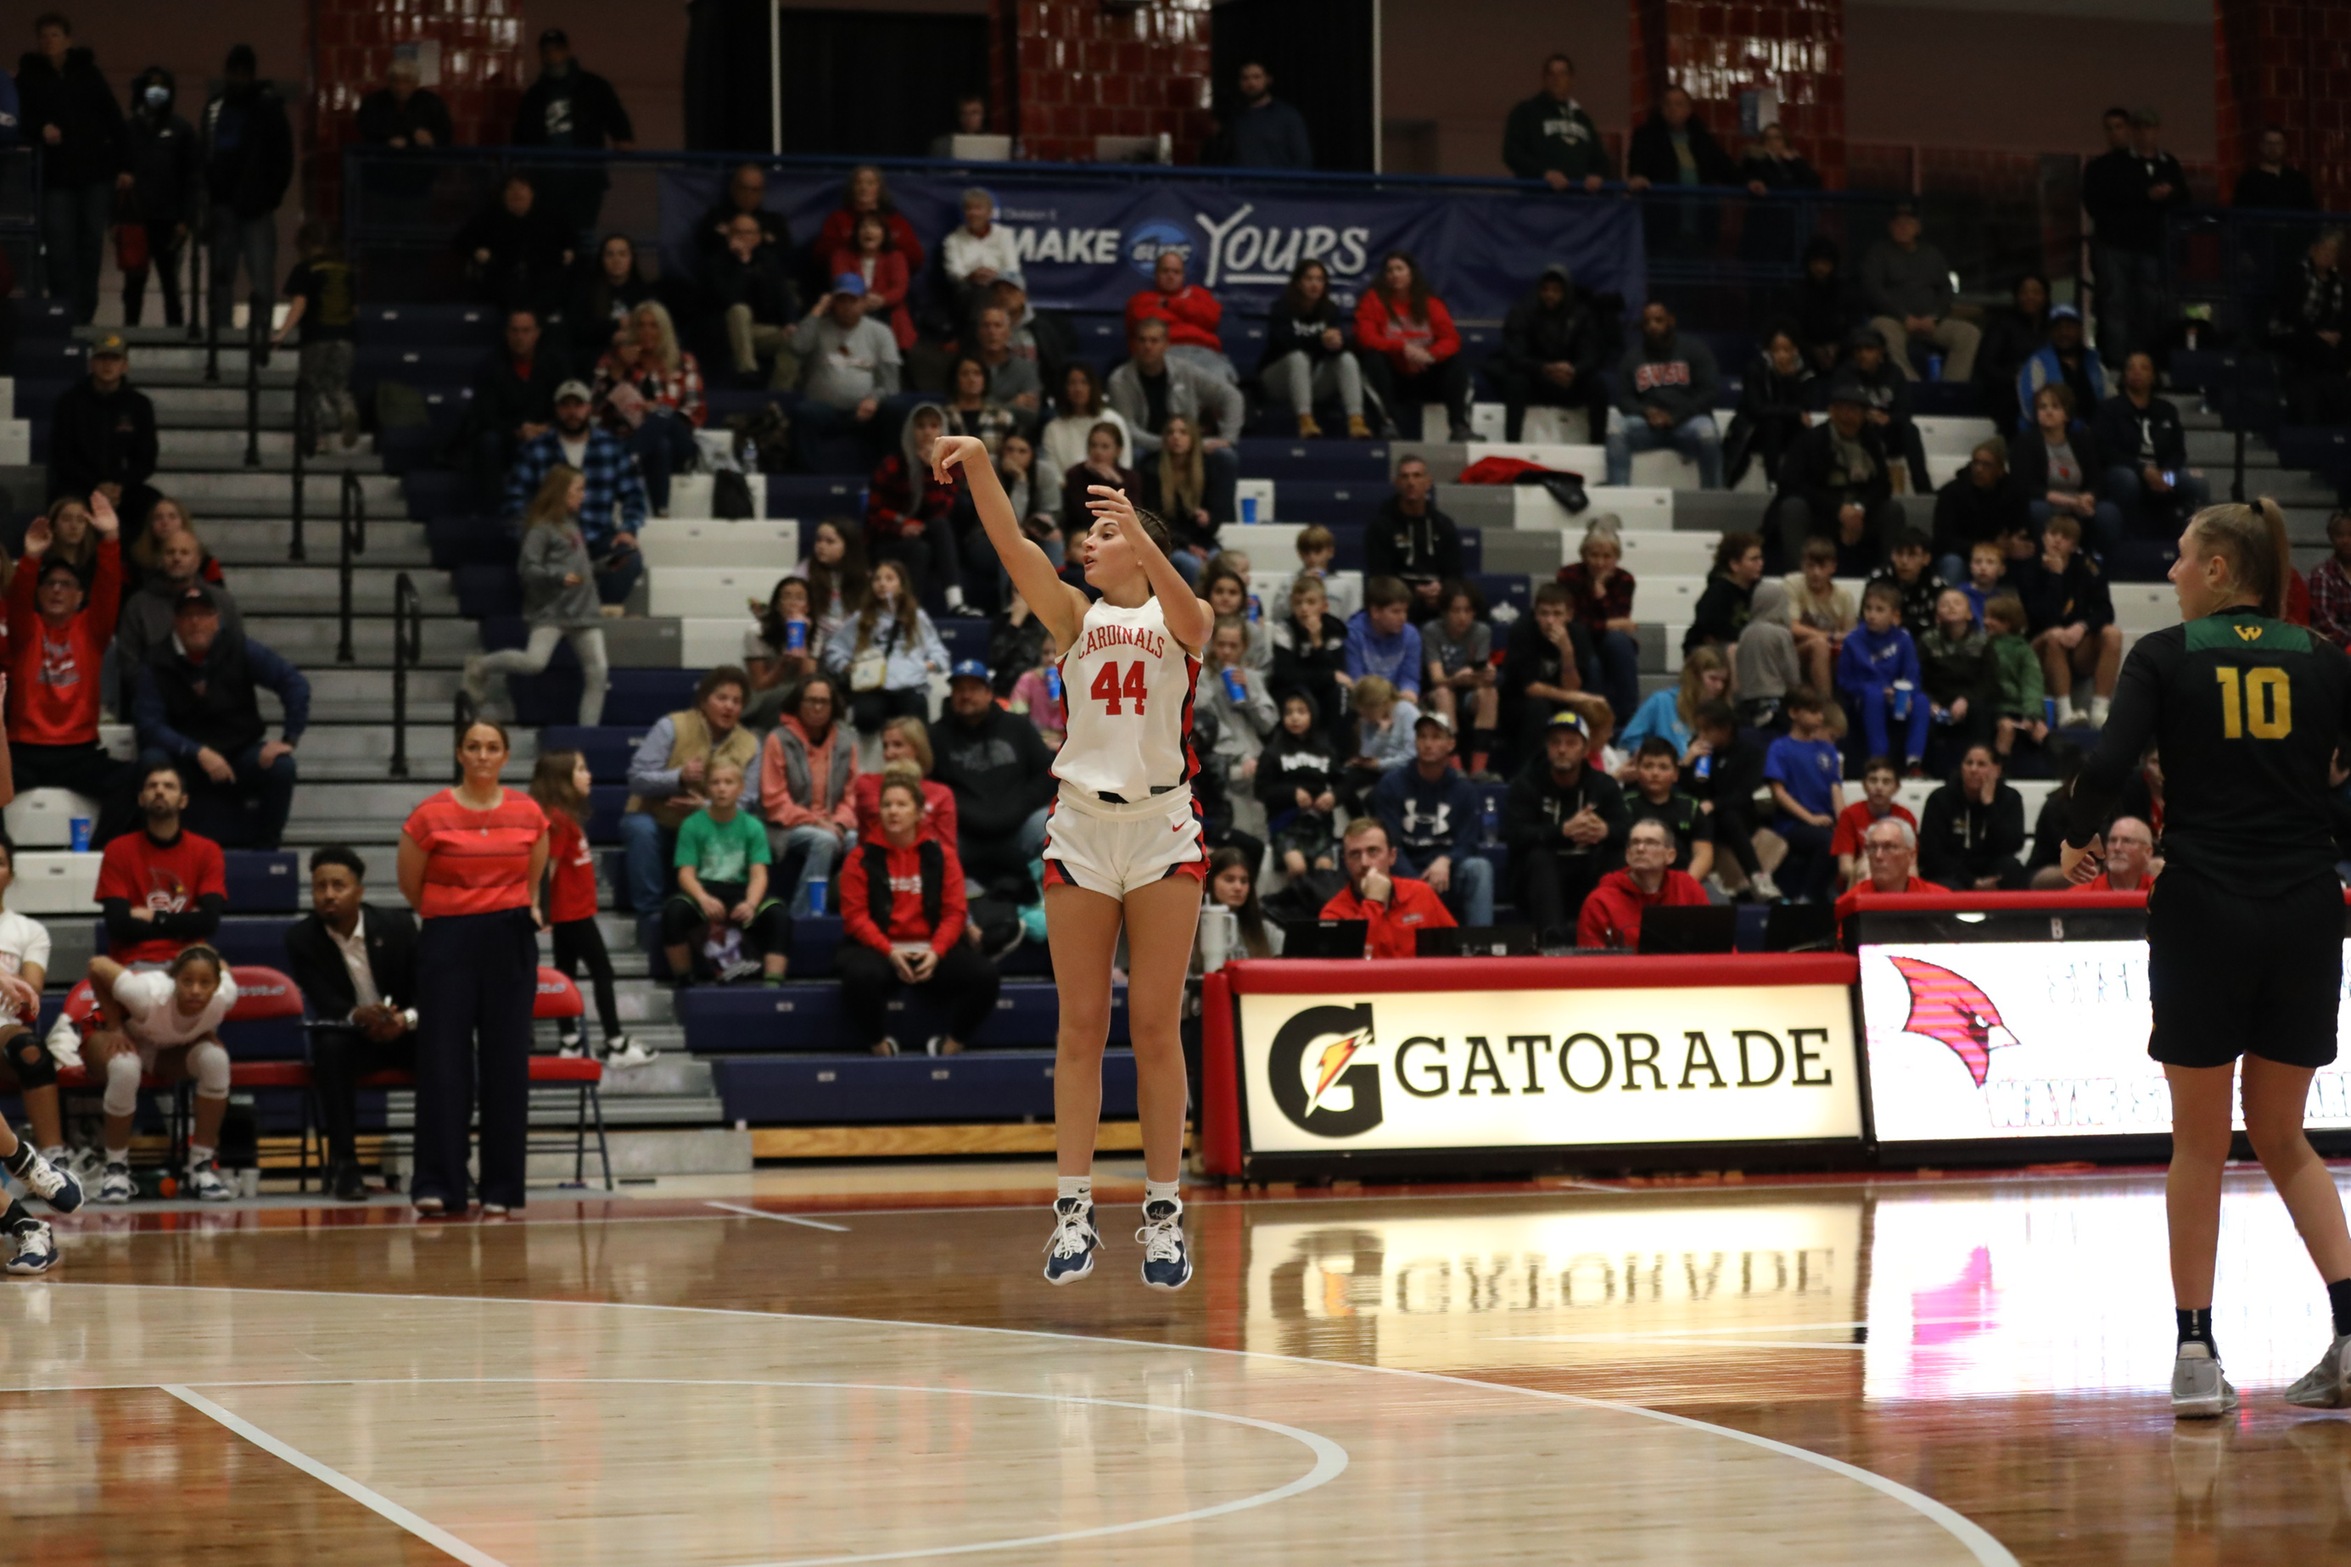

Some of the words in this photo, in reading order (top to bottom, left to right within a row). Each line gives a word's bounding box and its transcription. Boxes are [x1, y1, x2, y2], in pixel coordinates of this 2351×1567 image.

[1009, 227, 1121, 264] MAKE
[1078, 624, 1165, 660] CARDINALS
[1090, 660, 1148, 716] 44
[2215, 666, 2292, 740] 10
[1267, 1002, 1384, 1139] G
[1393, 1027, 1834, 1098] GATORADE
